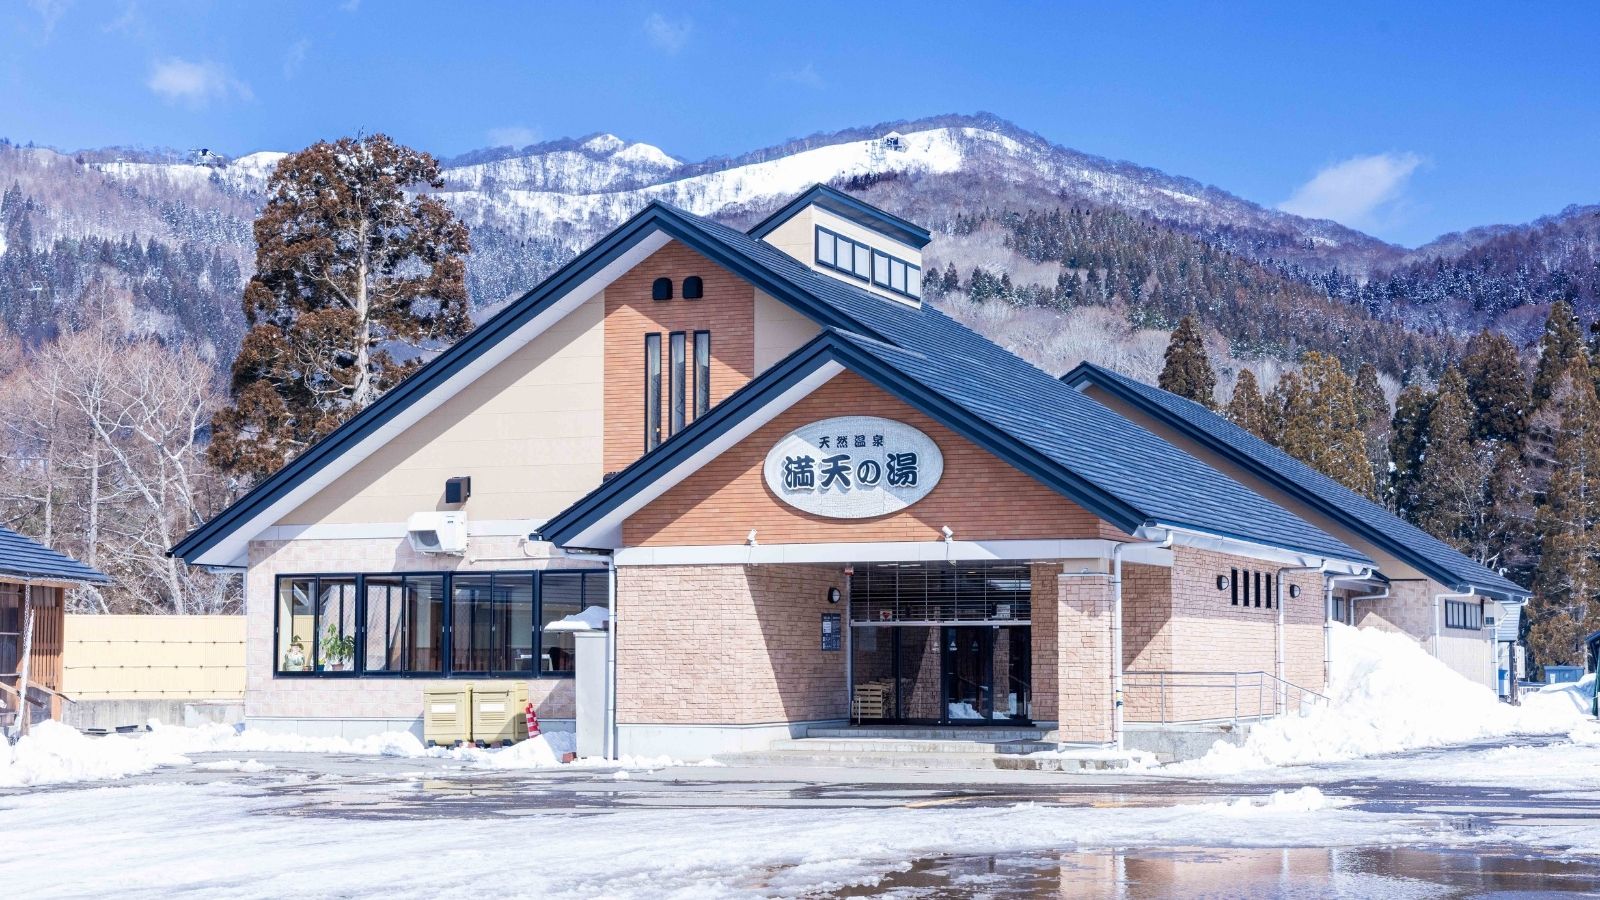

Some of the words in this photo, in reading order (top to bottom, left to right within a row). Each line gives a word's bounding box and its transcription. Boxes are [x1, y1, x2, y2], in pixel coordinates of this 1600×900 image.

[819, 435, 884, 448] 天然温泉
[784, 452, 918, 489] 満天の湯
